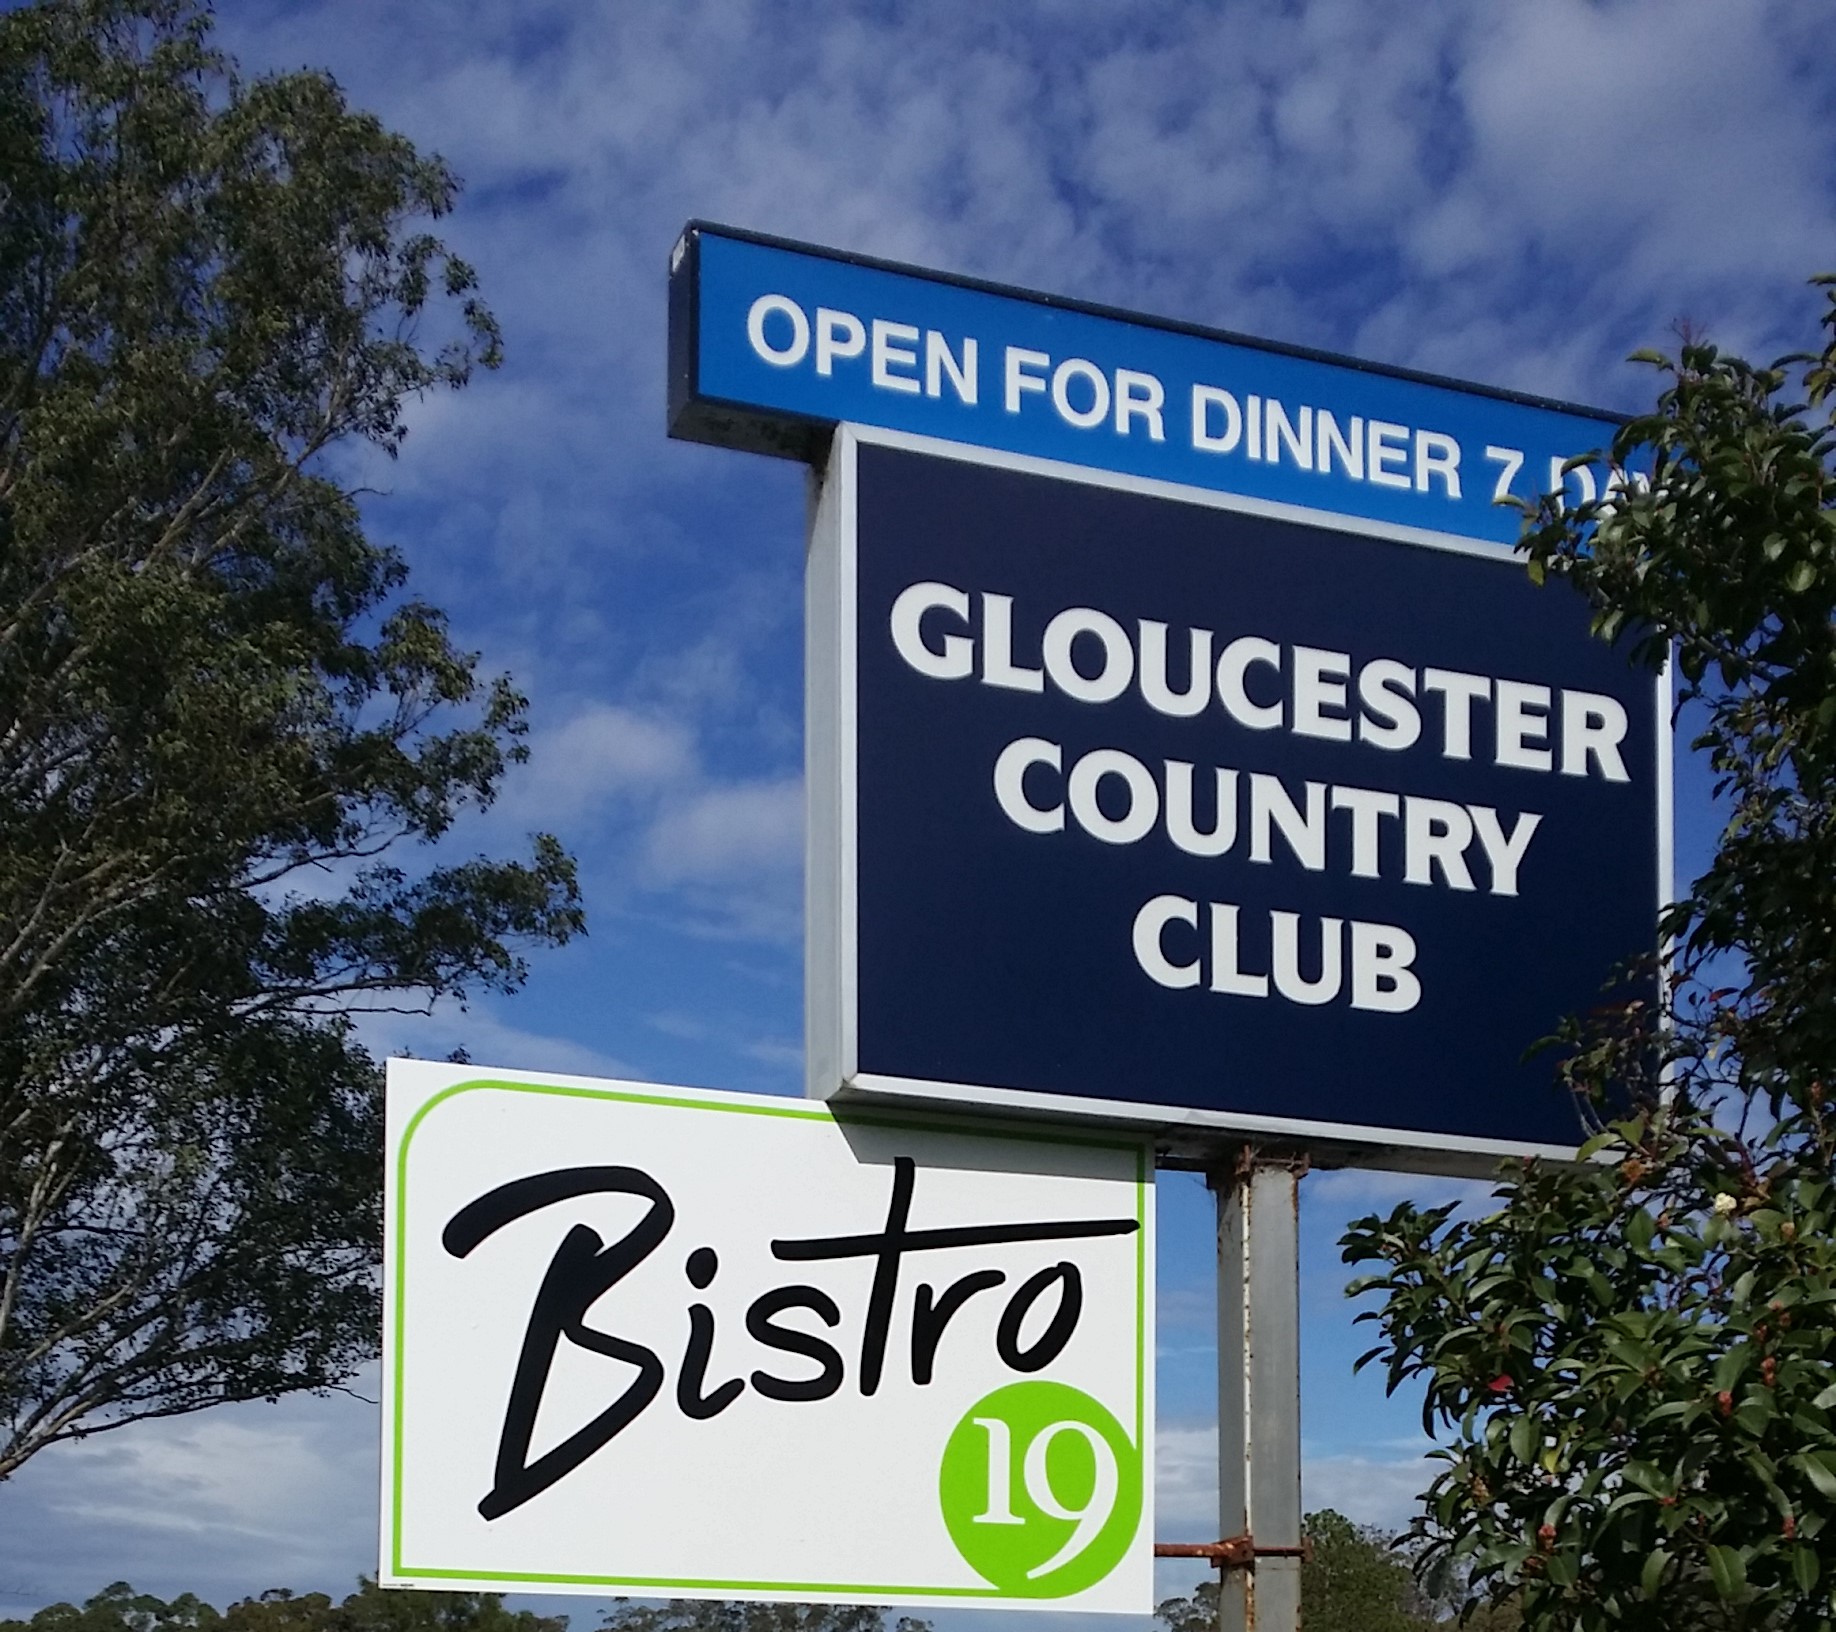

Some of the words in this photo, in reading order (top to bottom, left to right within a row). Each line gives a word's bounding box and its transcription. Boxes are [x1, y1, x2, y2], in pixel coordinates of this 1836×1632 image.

[747, 293, 978, 404] OPEN
[1005, 346, 1165, 441] FOR
[1192, 384, 1462, 498] DINNER
[1486, 445, 1524, 506] 7
[1551, 455, 1652, 519] DA
[890, 581, 1631, 783] GLOUCESTER
[994, 737, 1543, 897] COUNTRY
[1132, 894, 1421, 1013] CLUB
[442, 1156, 1141, 1522] Bistro
[973, 1417, 1119, 1580] 19
